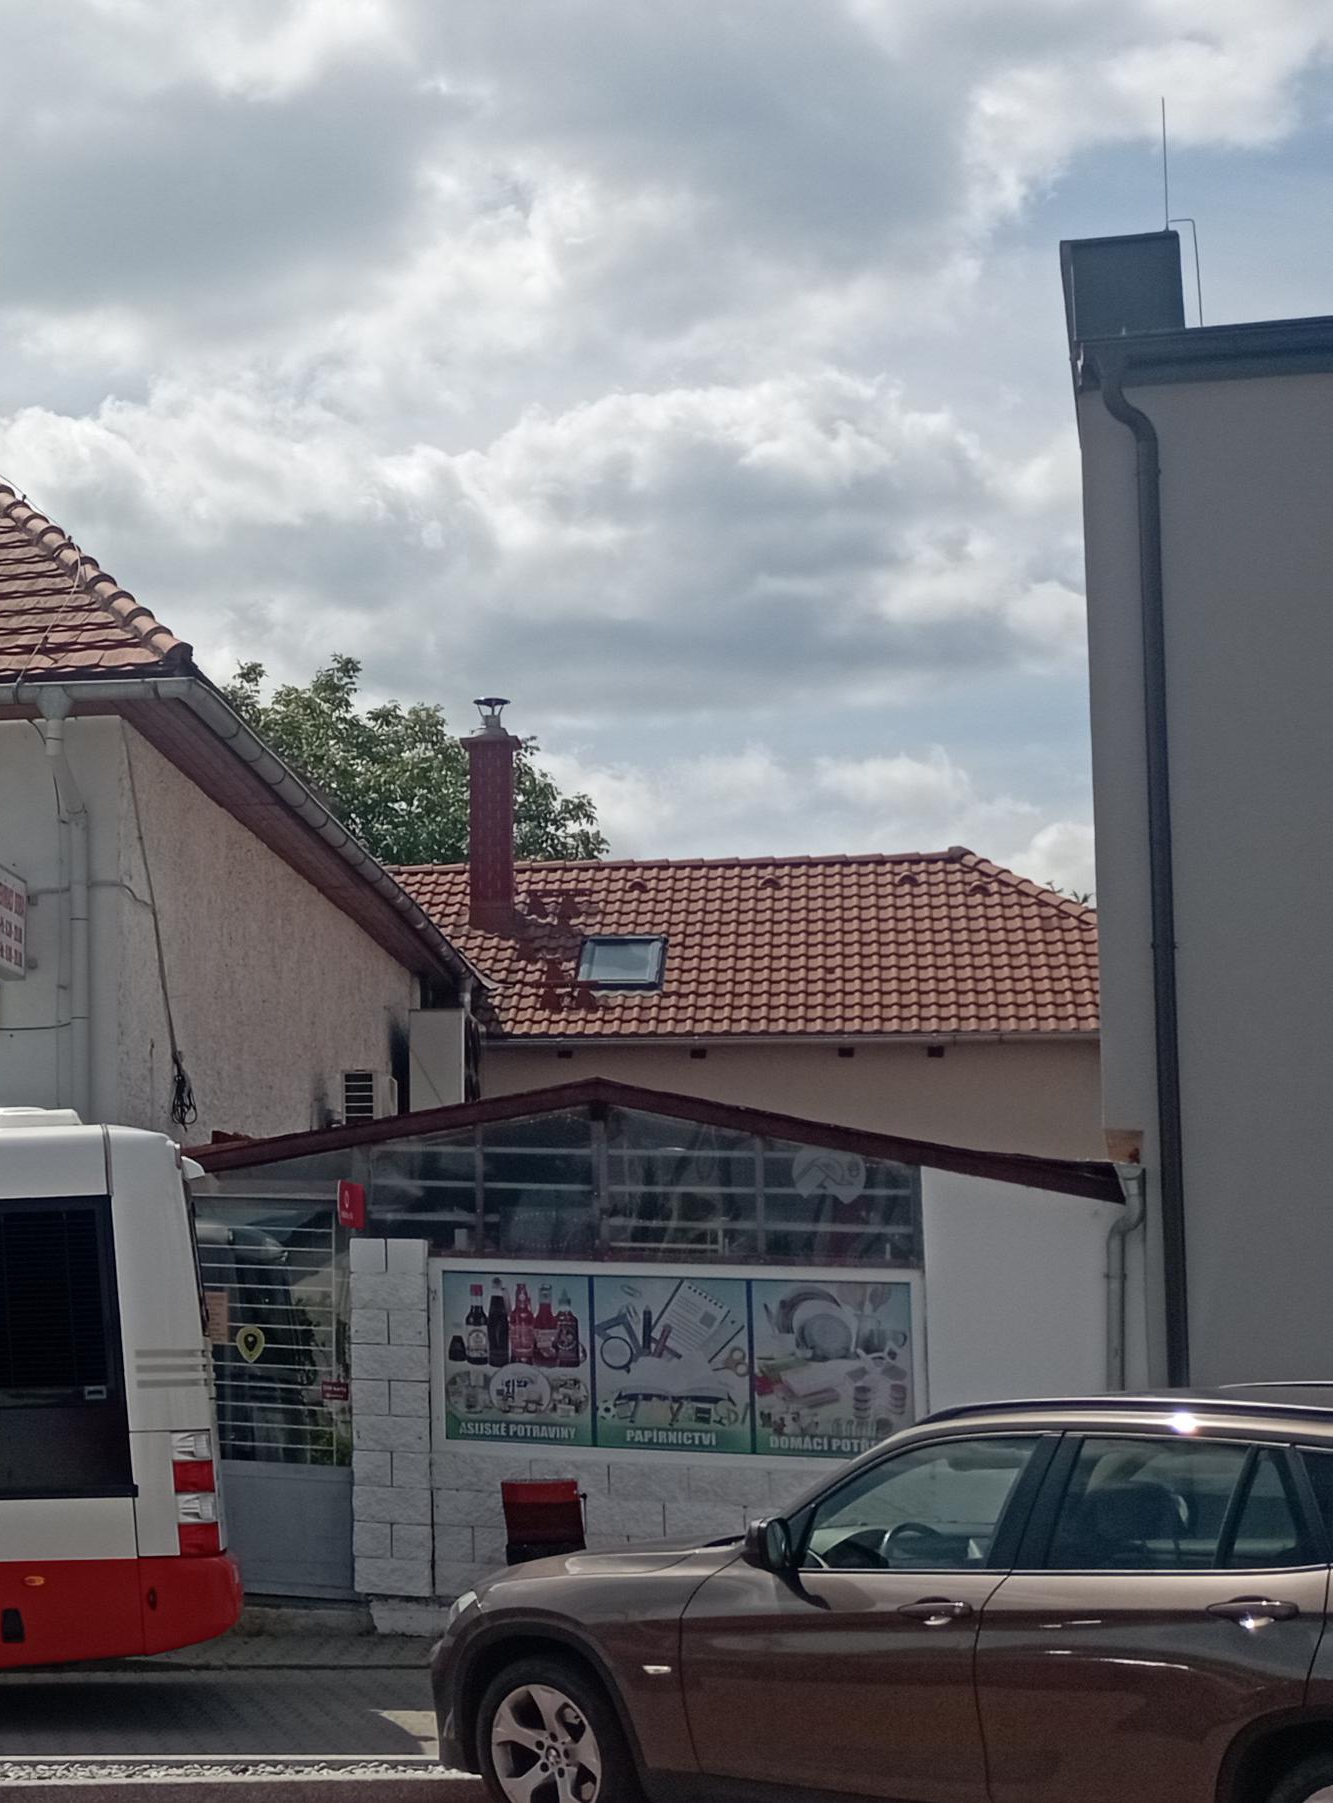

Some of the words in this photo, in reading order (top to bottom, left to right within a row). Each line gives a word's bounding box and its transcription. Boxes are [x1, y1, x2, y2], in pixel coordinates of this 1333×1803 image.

[459, 1421, 508, 1437] ASIJSKÉ
[509, 1424, 577, 1440] POTRAVINY
[626, 1429, 717, 1446] PAPÍRNICTVÍ
[769, 1435, 829, 1450] DOMÁCÍ
